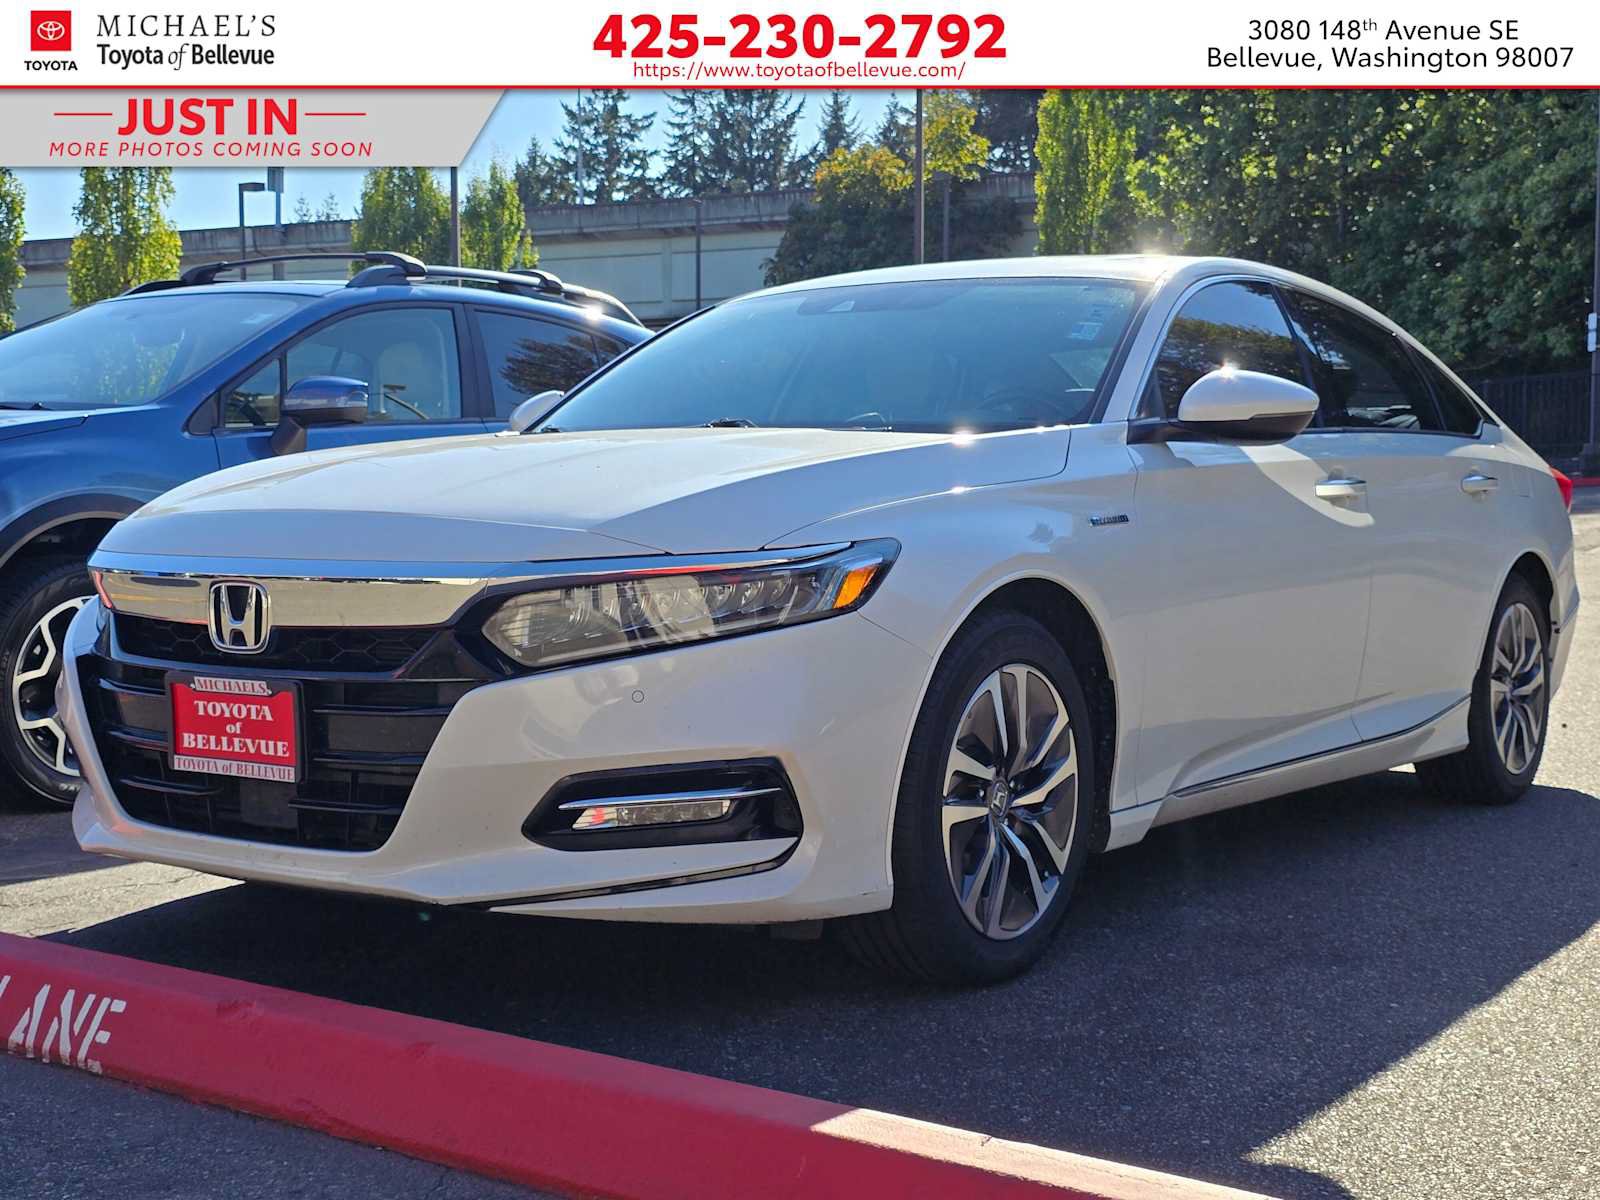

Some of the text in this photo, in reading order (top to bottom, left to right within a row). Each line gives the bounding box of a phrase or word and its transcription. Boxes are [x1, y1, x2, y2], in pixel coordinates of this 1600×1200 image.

[193, 700, 274, 722] TOYOTA
[225, 721, 243, 734] of
[182, 732, 290, 757] BELLEVUE
[175, 757, 218, 773] TOYOTA
[236, 763, 294, 780] BELLEVUE
